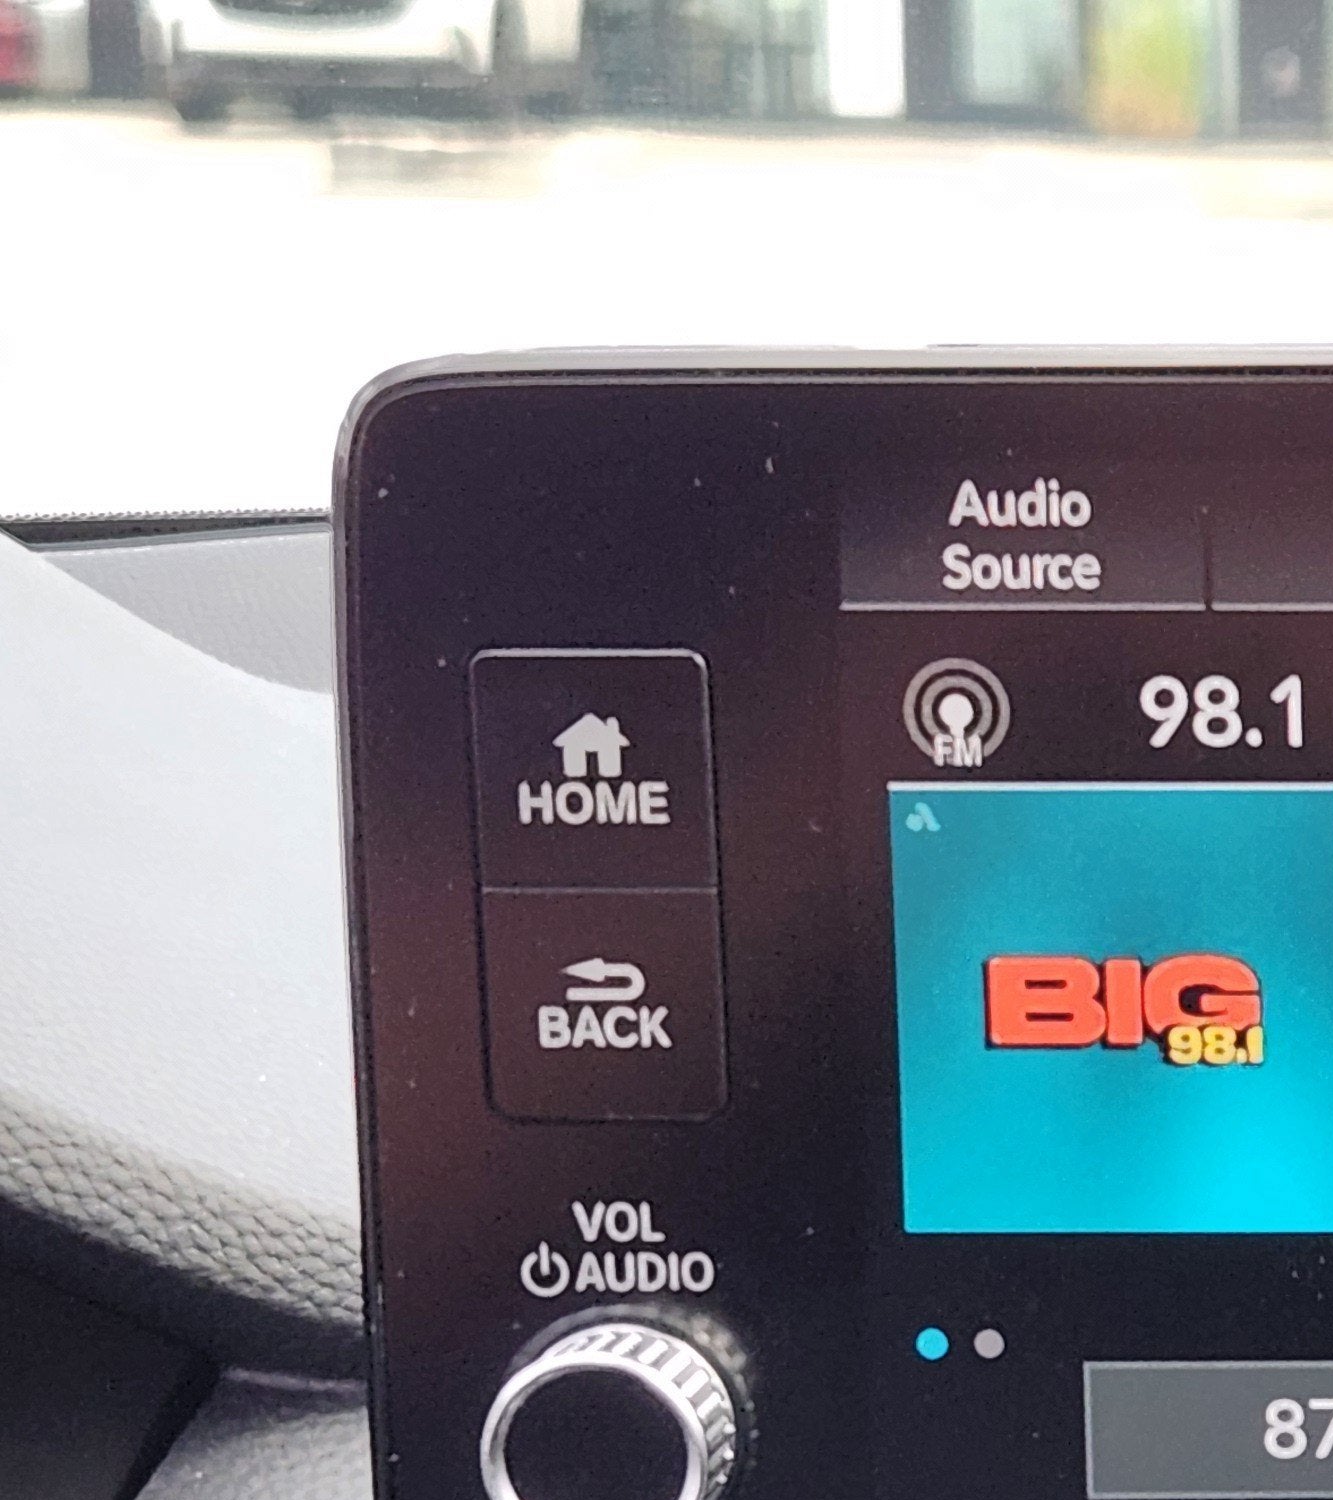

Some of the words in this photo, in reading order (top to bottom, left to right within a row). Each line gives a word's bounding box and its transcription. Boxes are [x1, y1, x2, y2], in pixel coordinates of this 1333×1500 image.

[948, 477, 1092, 528] Audio
[942, 543, 1102, 591] Source
[1139, 674, 1303, 748] 98.1
[934, 733, 983, 767] FM
[518, 780, 671, 825] HOME
[988, 955, 1262, 1045] BIG
[538, 1005, 672, 1049] BACK
[1166, 1025, 1264, 1065] 98.1
[571, 1200, 666, 1243] VOL
[575, 1251, 715, 1293] AUDIO
